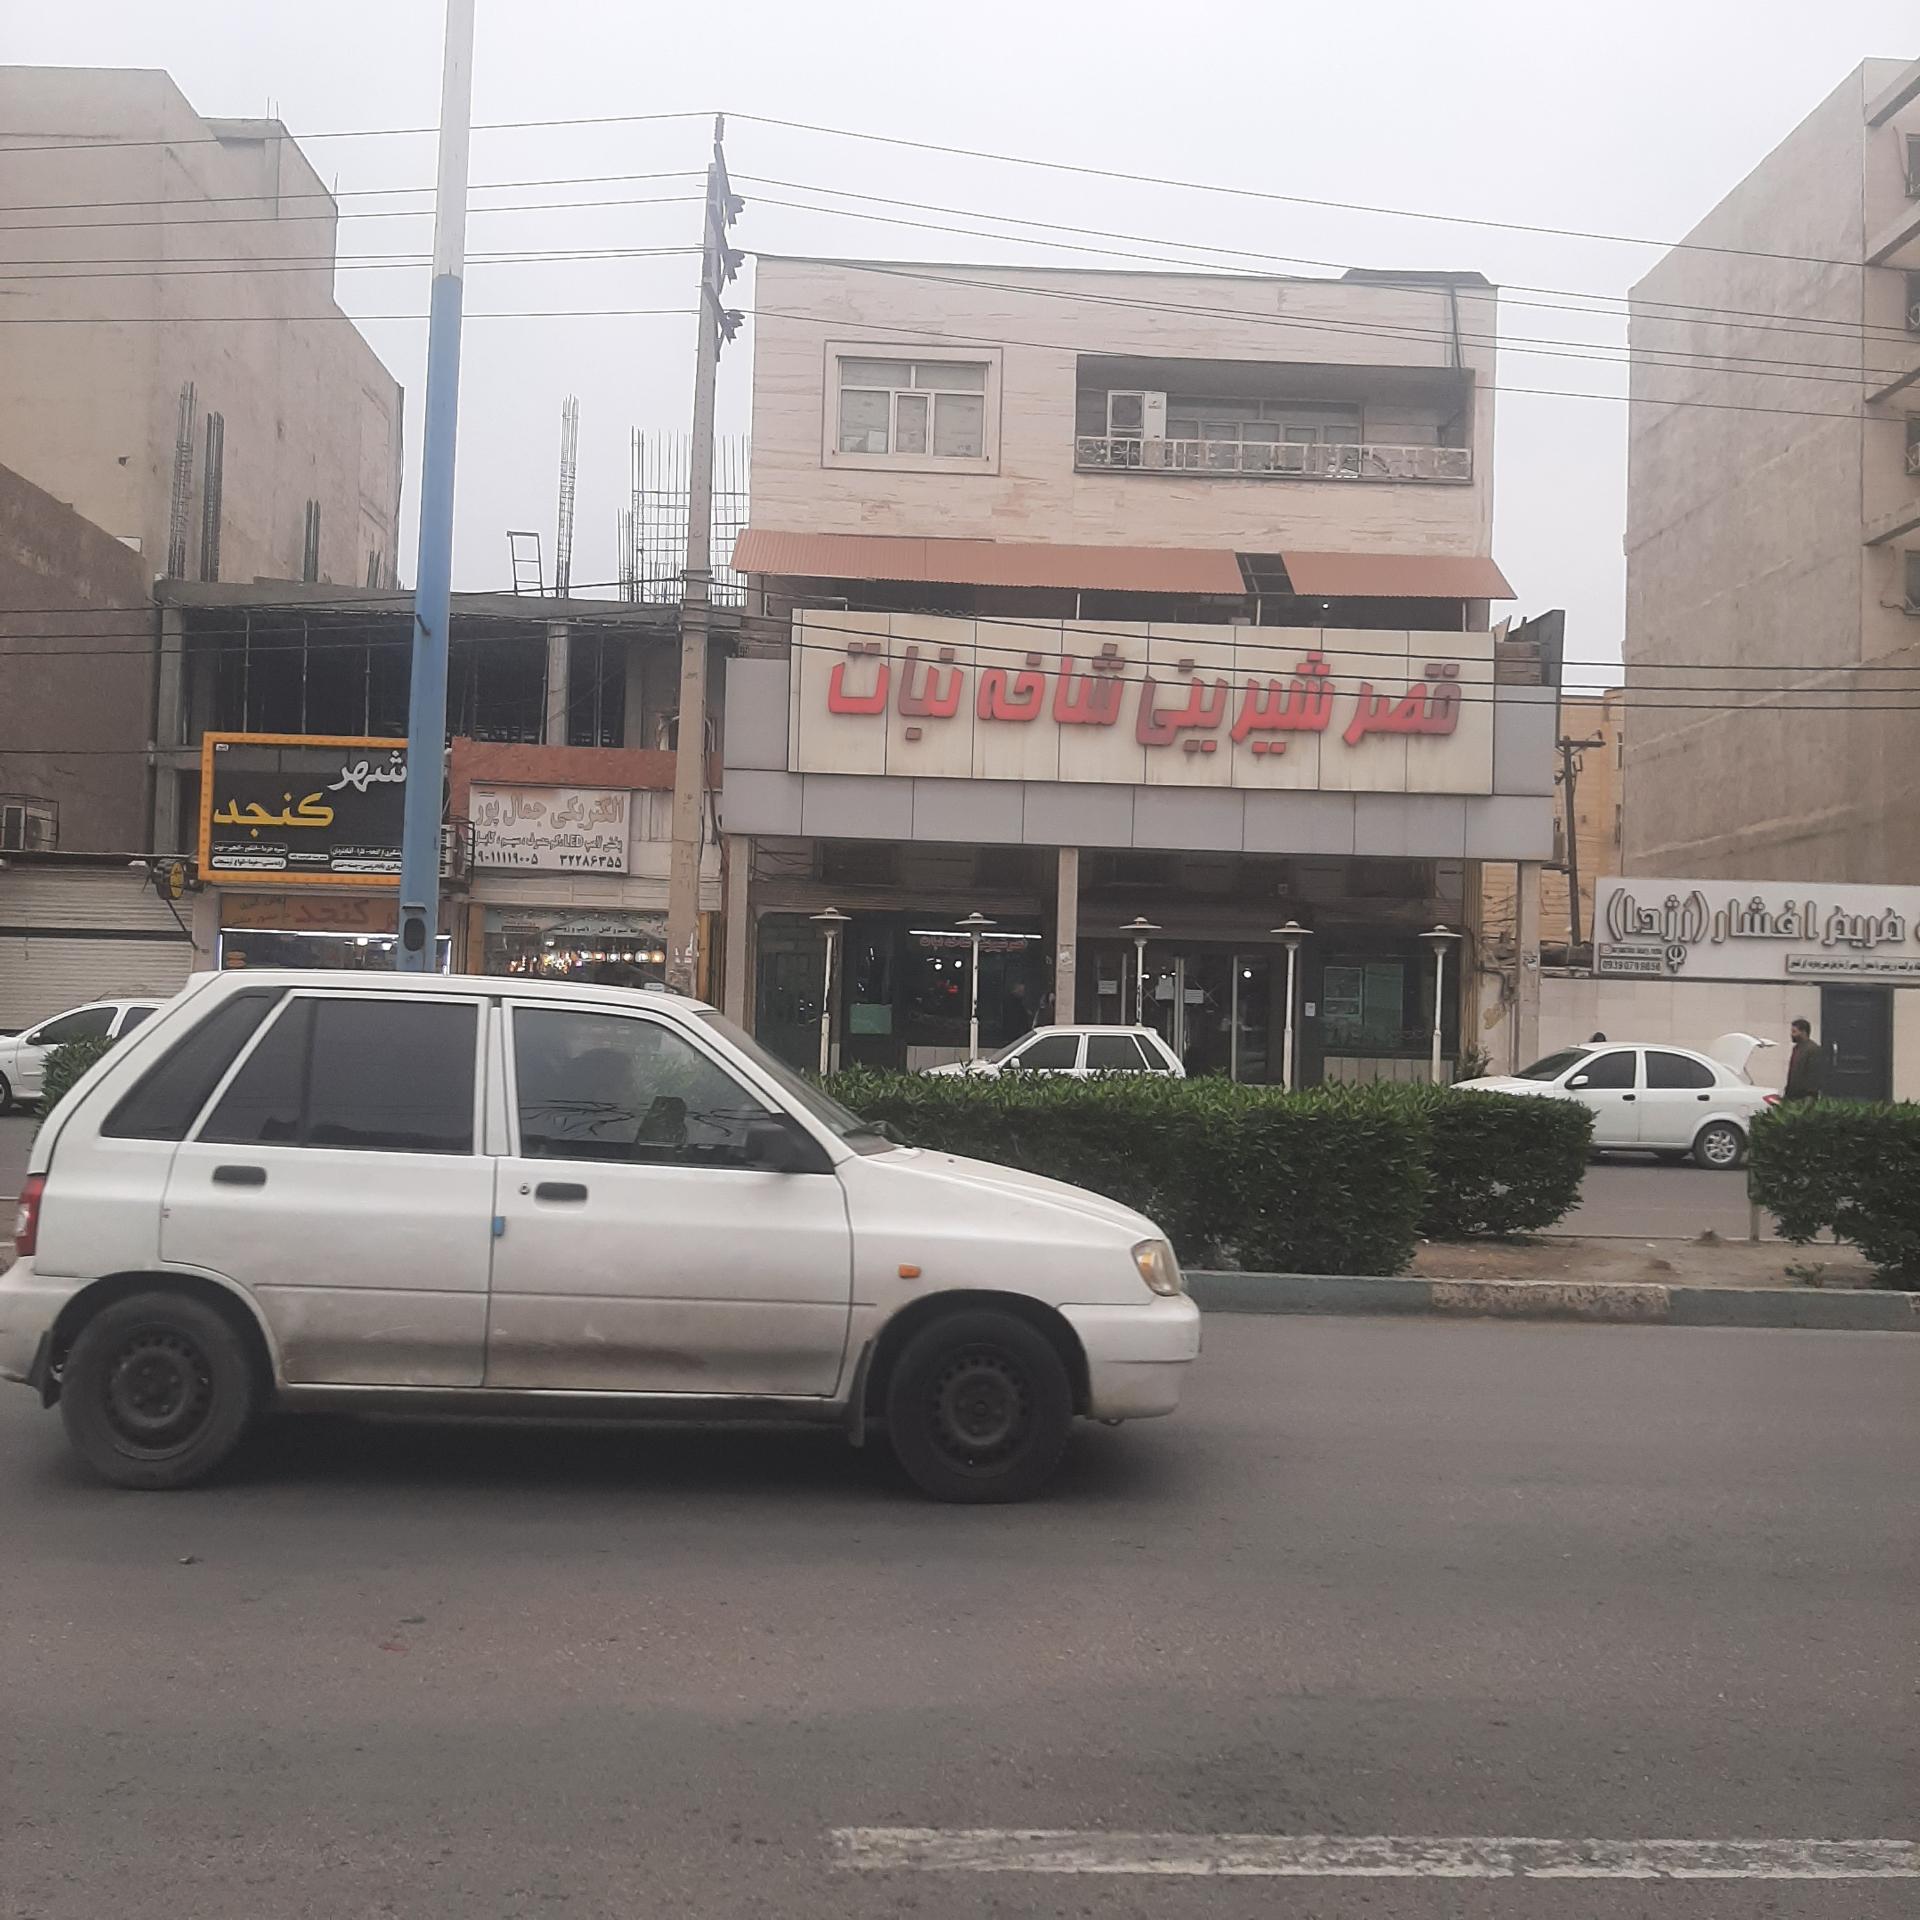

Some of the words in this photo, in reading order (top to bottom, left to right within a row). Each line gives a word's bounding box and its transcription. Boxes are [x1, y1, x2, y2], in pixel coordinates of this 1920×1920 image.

[827, 641, 964, 741] نبات
[977, 641, 1125, 727] شاخه
[1135, 650, 1336, 754] شیرینی
[1343, 663, 1462, 746] قصر
[327, 750, 407, 793] شهر
[213, 792, 335, 838] کنجد
[475, 799, 500, 827] پور
[502, 794, 547, 828] جمال
[475, 851, 539, 866] ۹۰۱۱۱۱۹۰۰۵
